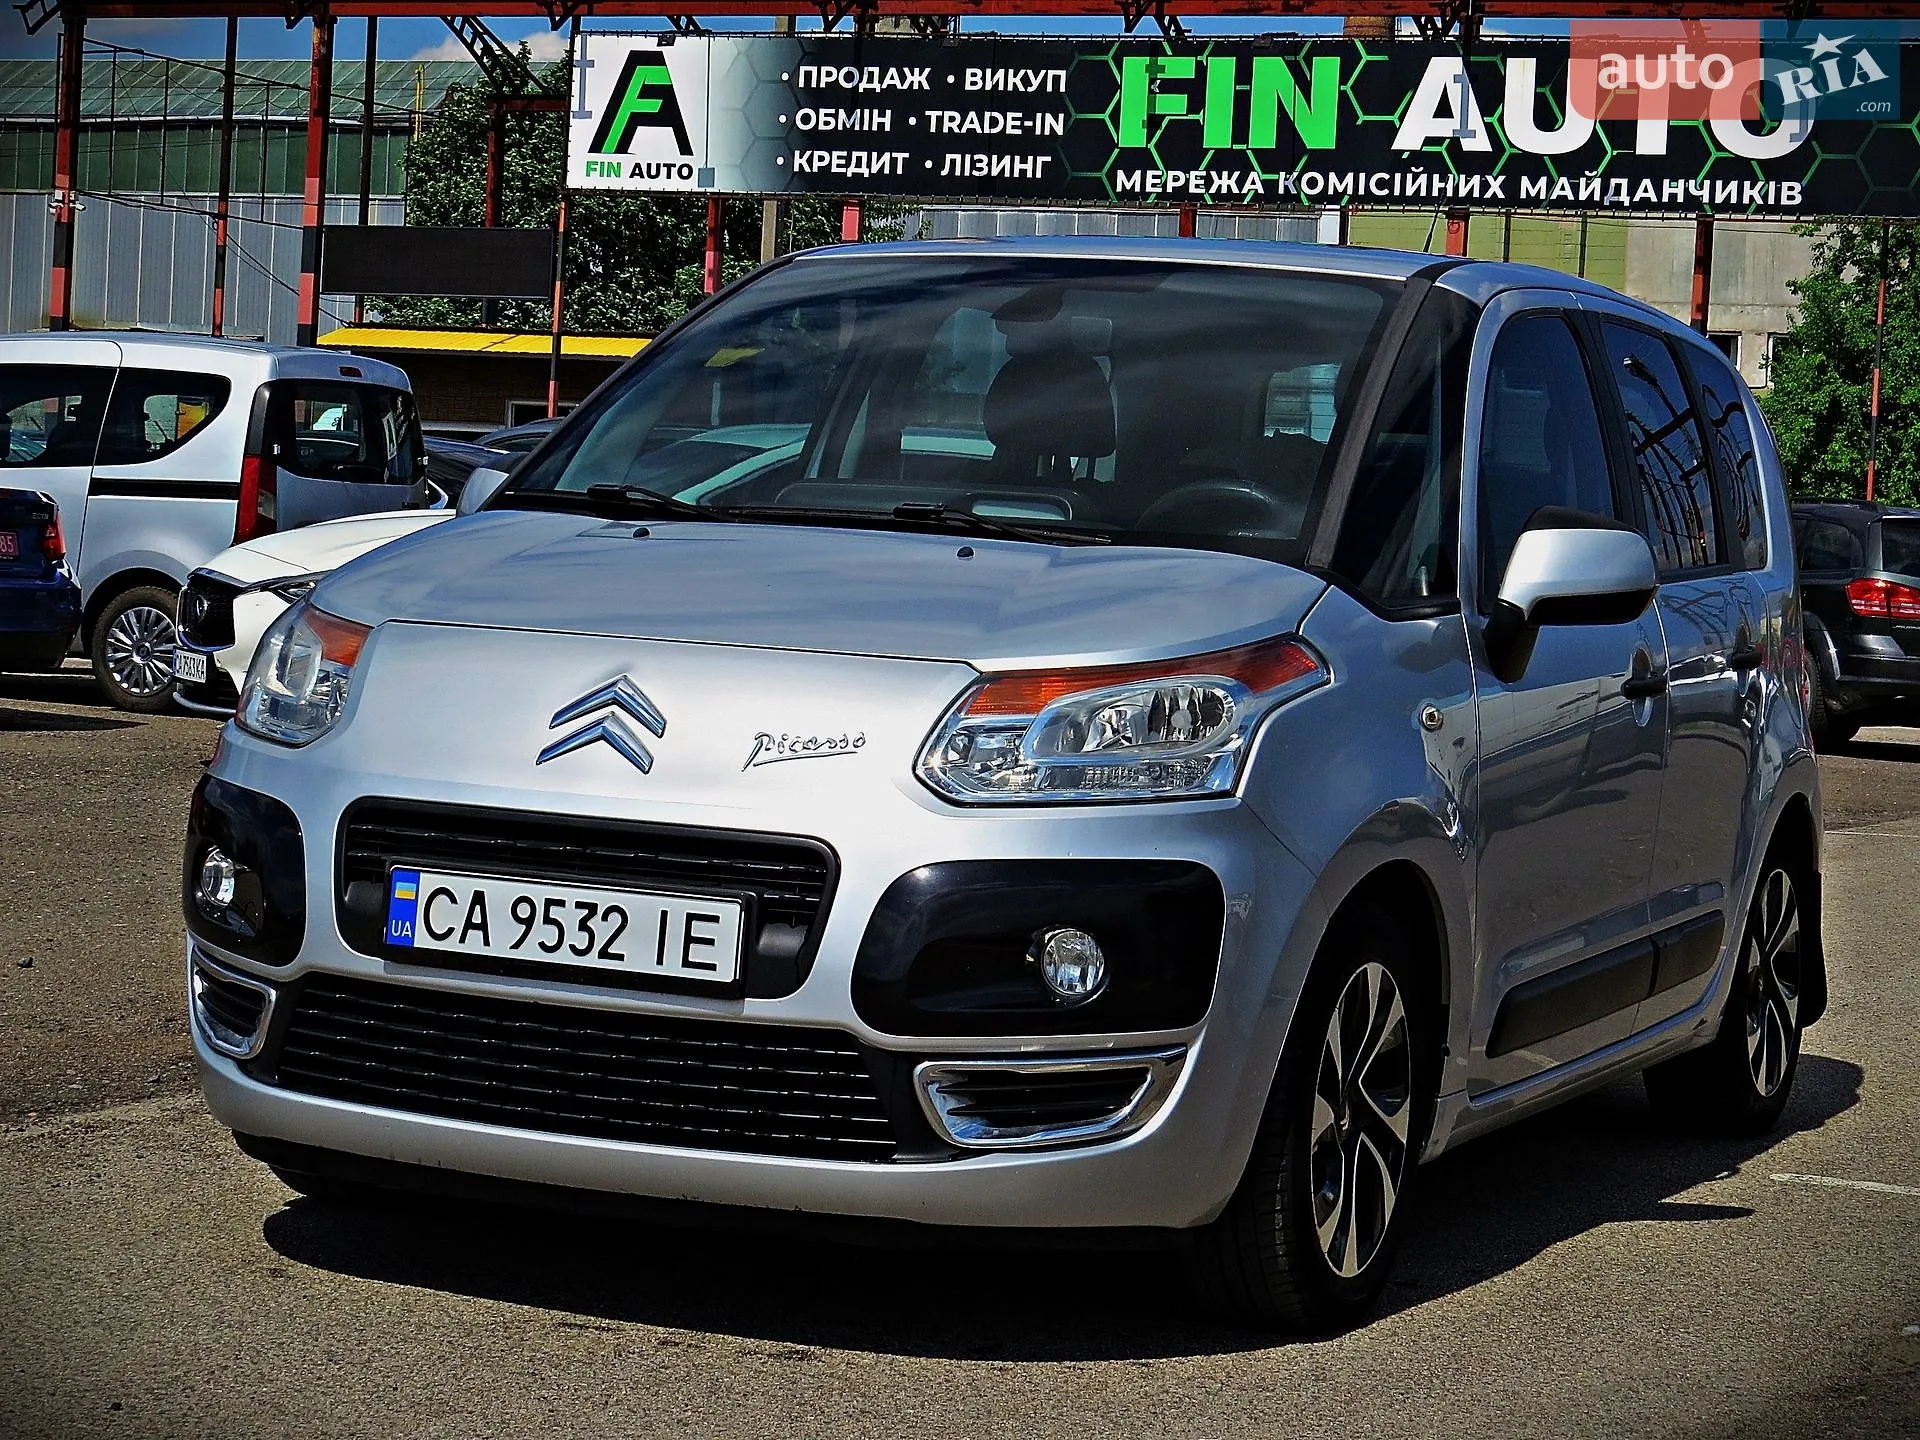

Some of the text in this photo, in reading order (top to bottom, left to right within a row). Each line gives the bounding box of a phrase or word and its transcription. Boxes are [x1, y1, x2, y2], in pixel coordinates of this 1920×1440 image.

[797, 65, 931, 92] ПРОДАЖ
[963, 67, 1067, 93] ВИКУП
[794, 107, 892, 132] ОБМІН
[1117, 55, 1817, 160] FIN AUTO
[925, 110, 1065, 136] TRADE-IN
[585, 160, 694, 180] FIN AUTO
[792, 151, 909, 178] КРЕДИТ
[940, 153, 1053, 179] ЛІЗИНГ
[1115, 166, 1803, 206] МЕРЕЖА КОМІСІЙНИХ МАЙДАНЧИКІВ
[741, 731, 866, 773] Picasso
[391, 919, 413, 939] UA
[422, 886, 721, 972] CA 9532 IE
